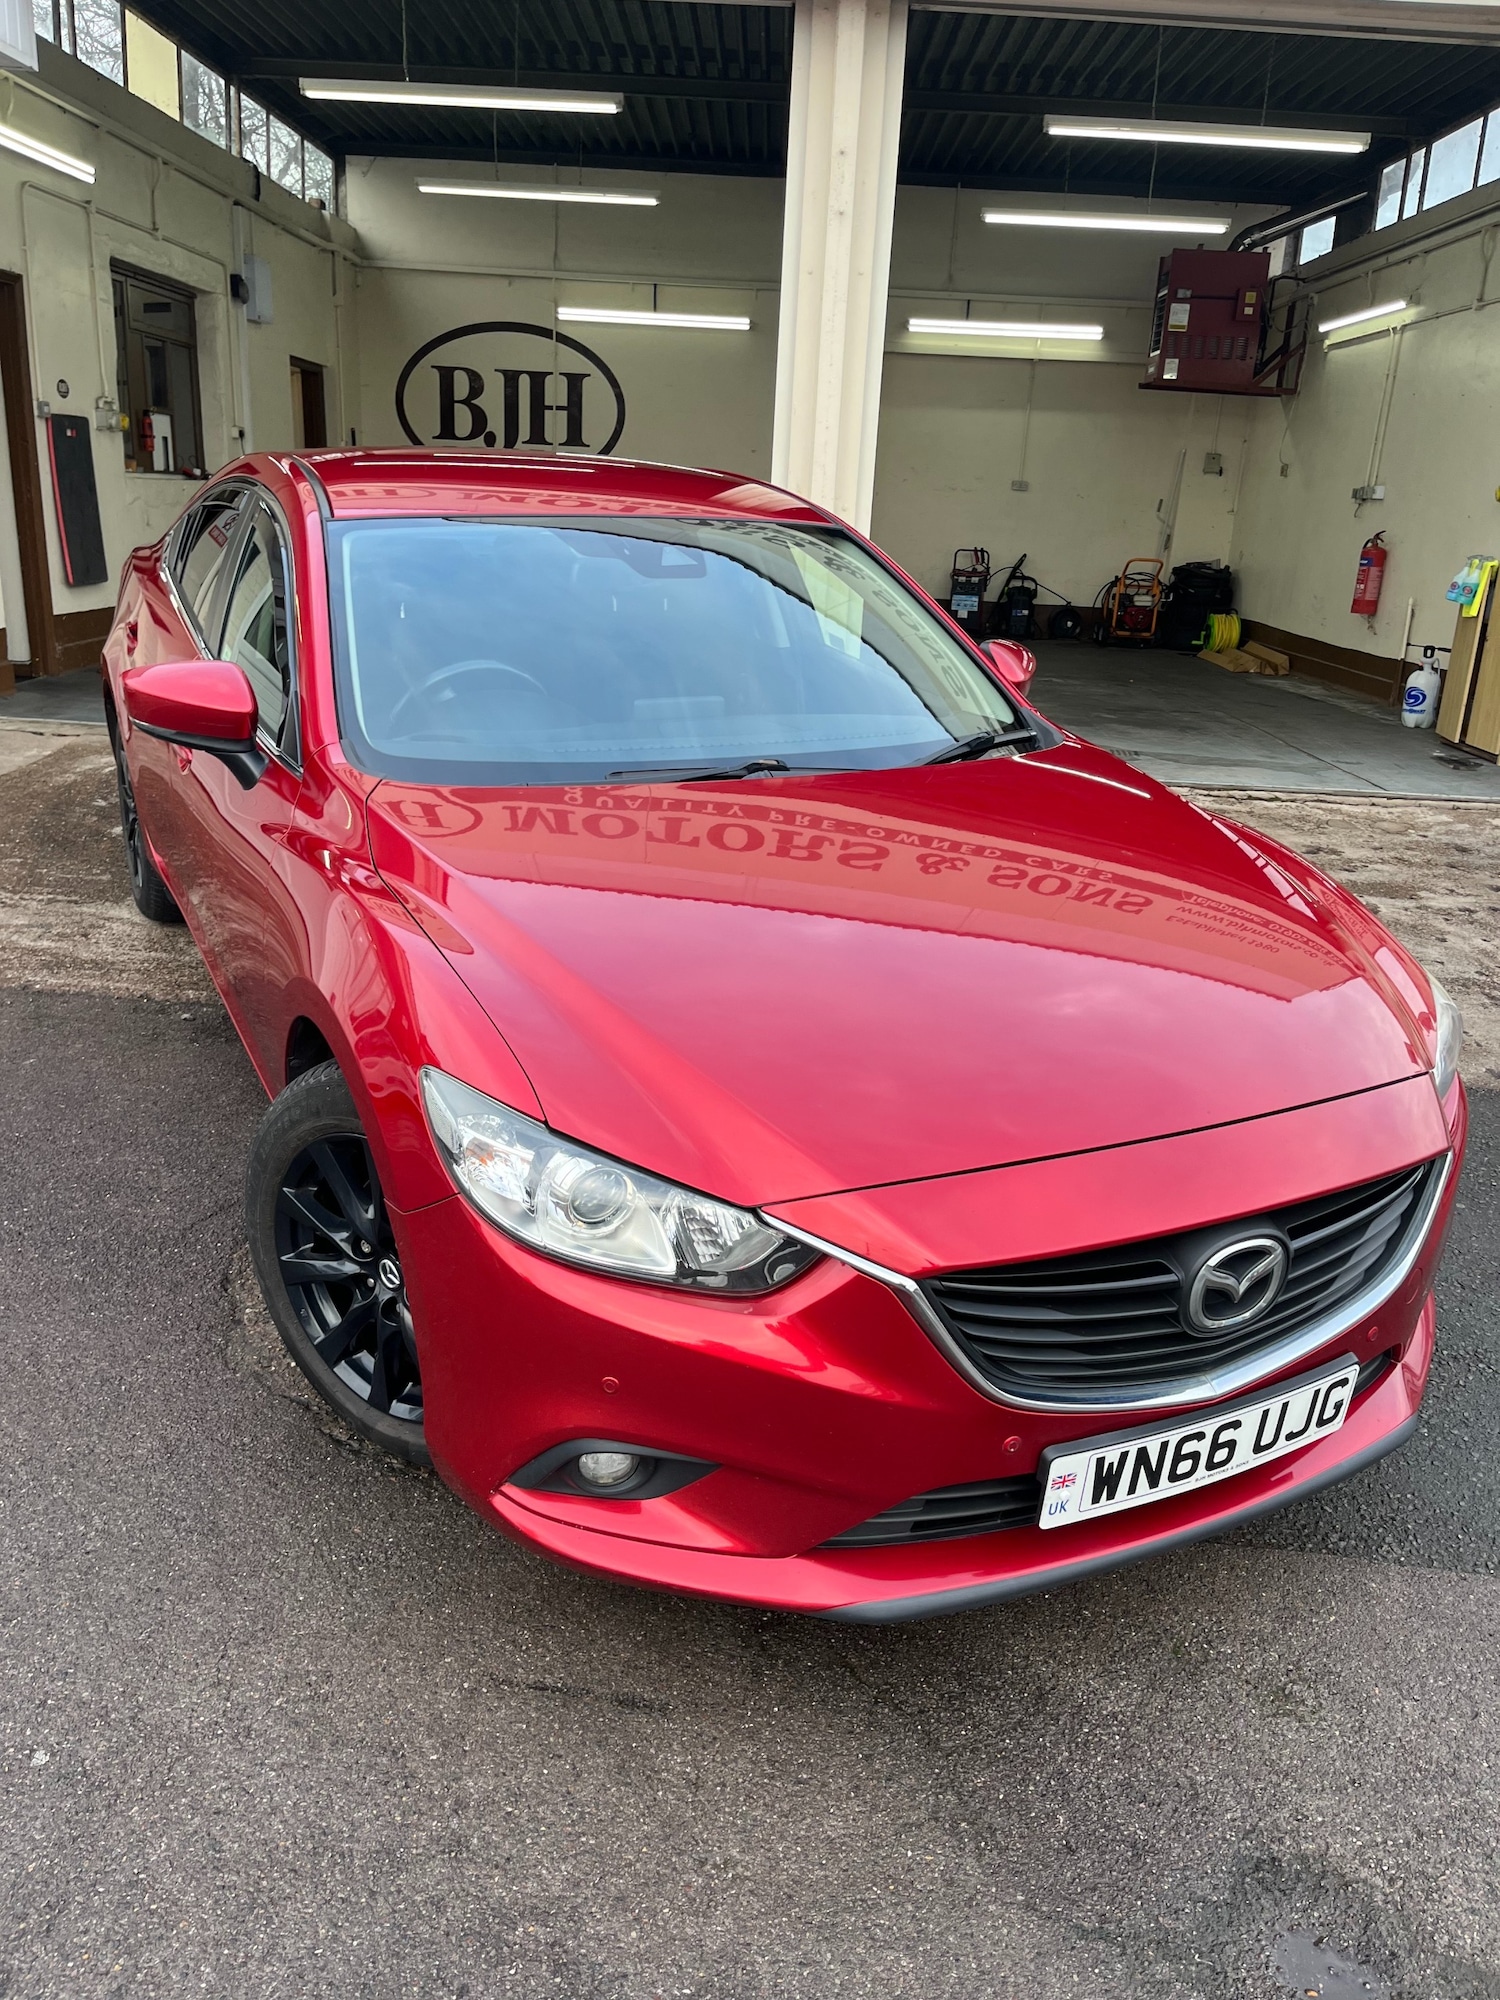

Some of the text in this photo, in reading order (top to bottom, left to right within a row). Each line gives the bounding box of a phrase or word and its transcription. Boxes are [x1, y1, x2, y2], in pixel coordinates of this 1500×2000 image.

[1090, 1376, 1350, 1505] WN66 UJG
[1048, 1499, 1068, 1516] UK
